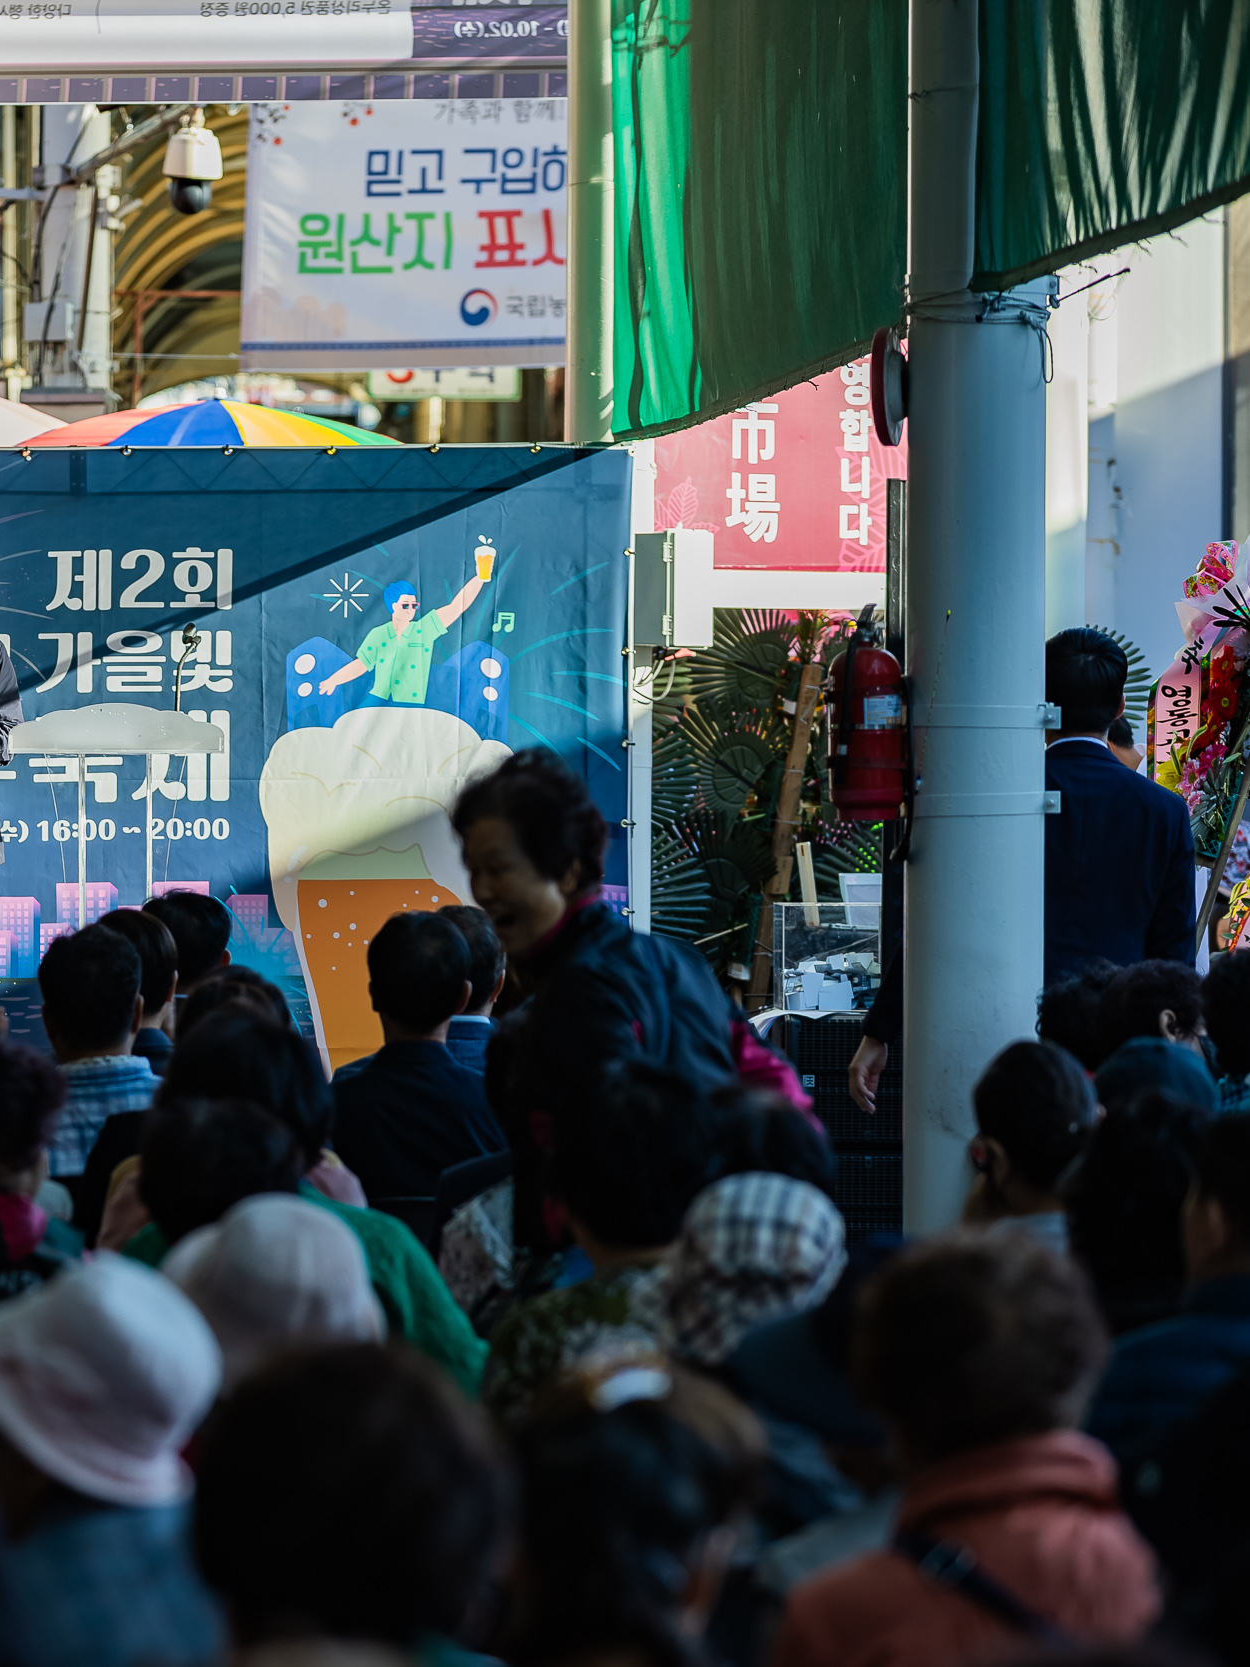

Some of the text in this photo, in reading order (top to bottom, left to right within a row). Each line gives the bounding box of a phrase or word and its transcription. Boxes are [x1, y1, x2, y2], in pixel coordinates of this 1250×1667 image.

[366, 149, 445, 197] 믿고
[297, 210, 454, 274] 원산지
[725, 401, 781, 543] 市場
[839, 361, 872, 546] 영합니다
[46, 547, 234, 612] 제2회
[35, 630, 234, 694] 가을빛
[36, 817, 117, 842] 16:00
[150, 817, 231, 841] 20:00
